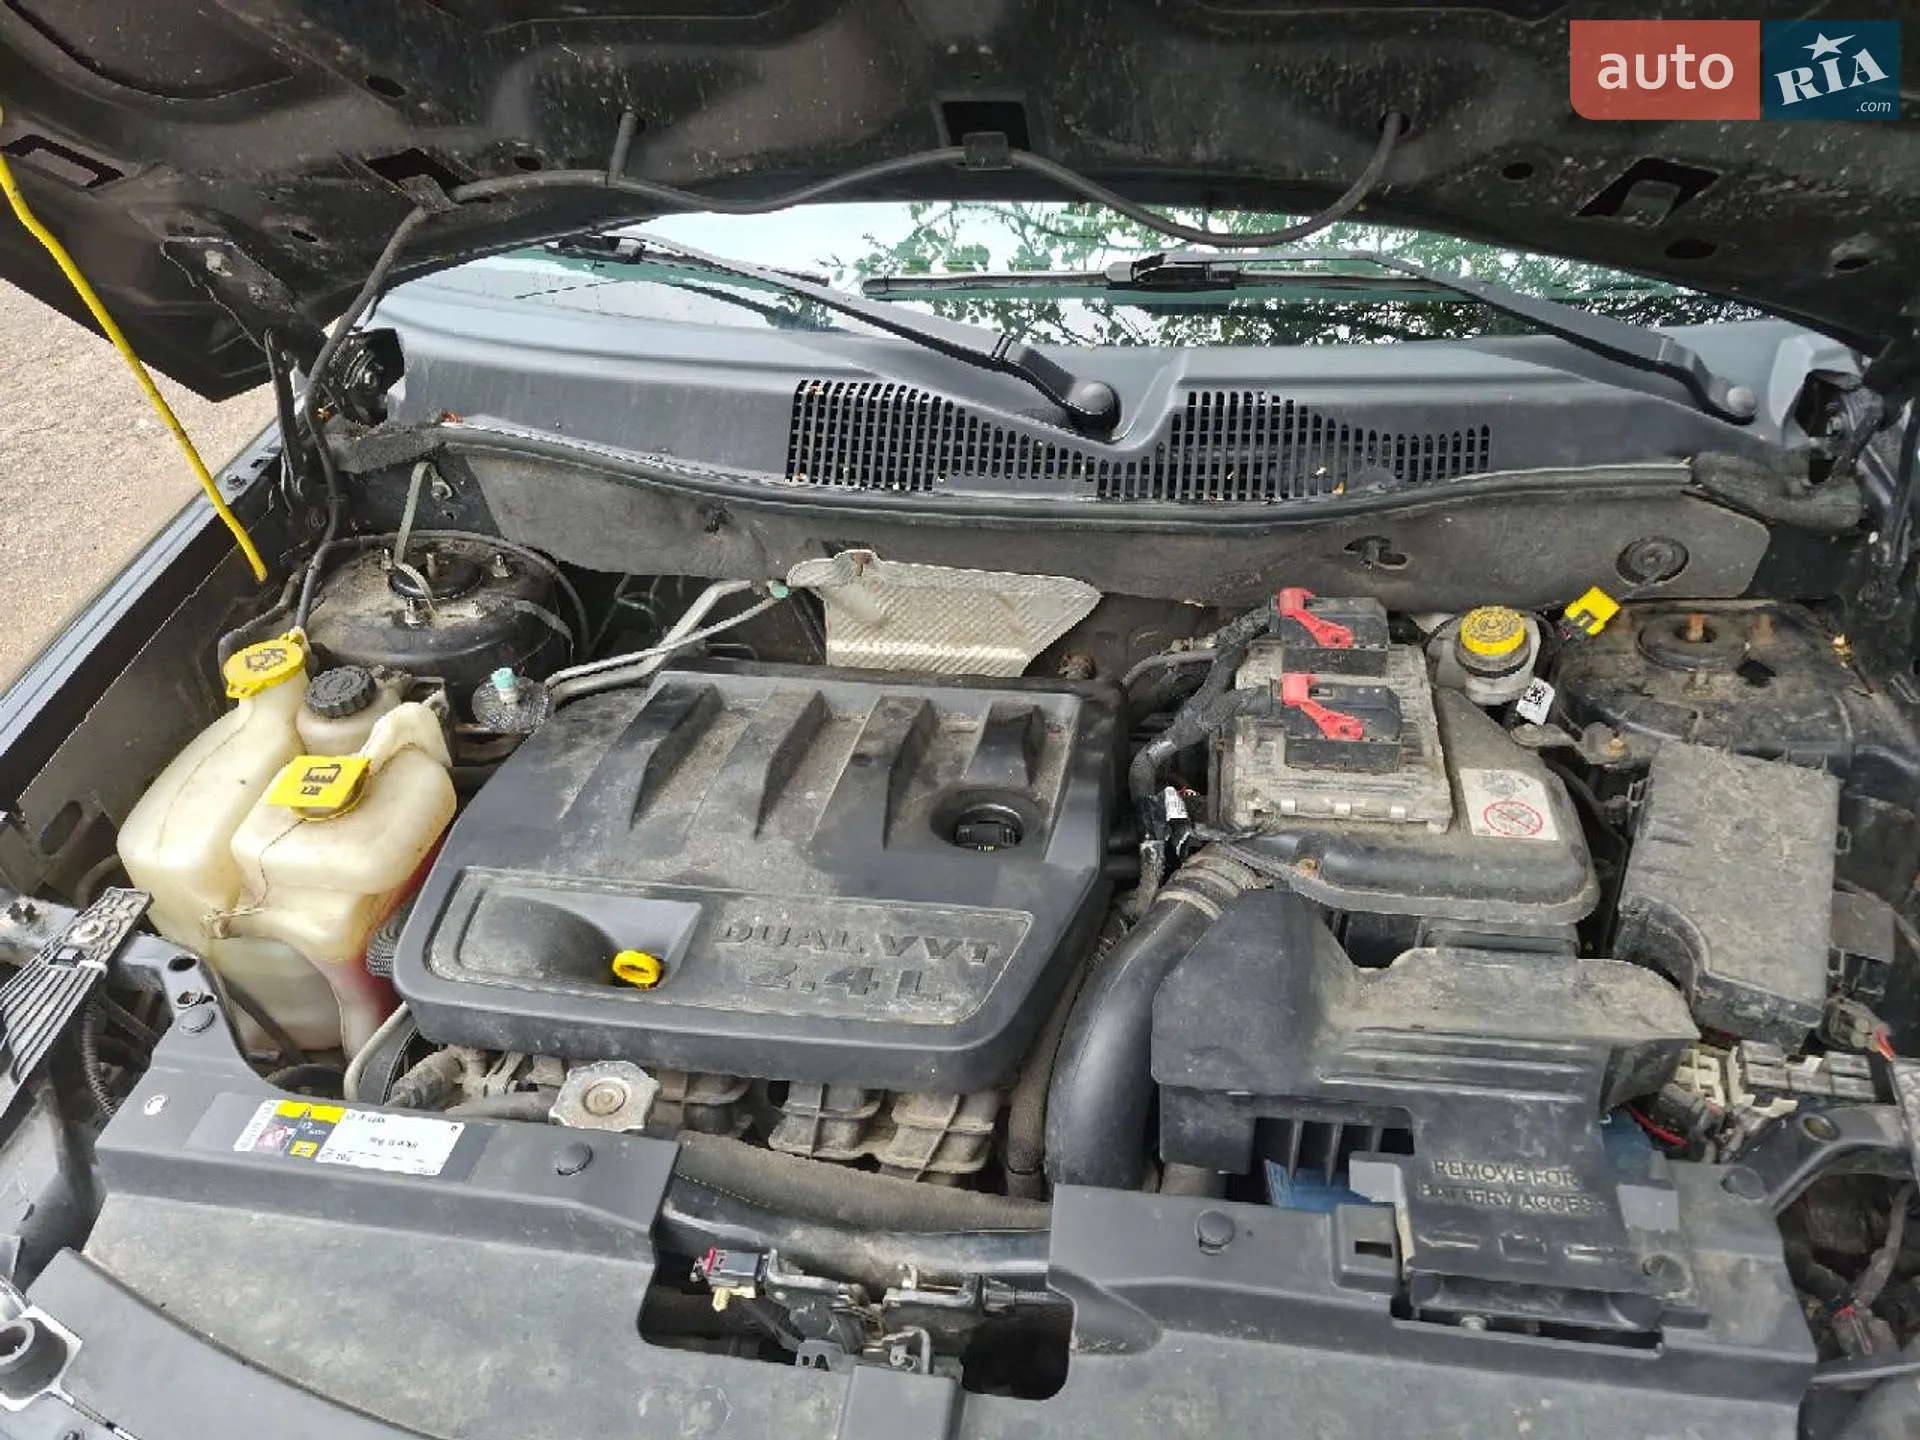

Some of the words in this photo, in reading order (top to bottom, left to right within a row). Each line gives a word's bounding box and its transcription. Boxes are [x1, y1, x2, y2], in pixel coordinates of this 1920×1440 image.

[714, 924, 870, 957] DUAL
[878, 932, 999, 966] VVT
[745, 962, 942, 1003] 2.4L
[1431, 1158, 1526, 1185] REMOVE
[1530, 1166, 1578, 1189] FOR
